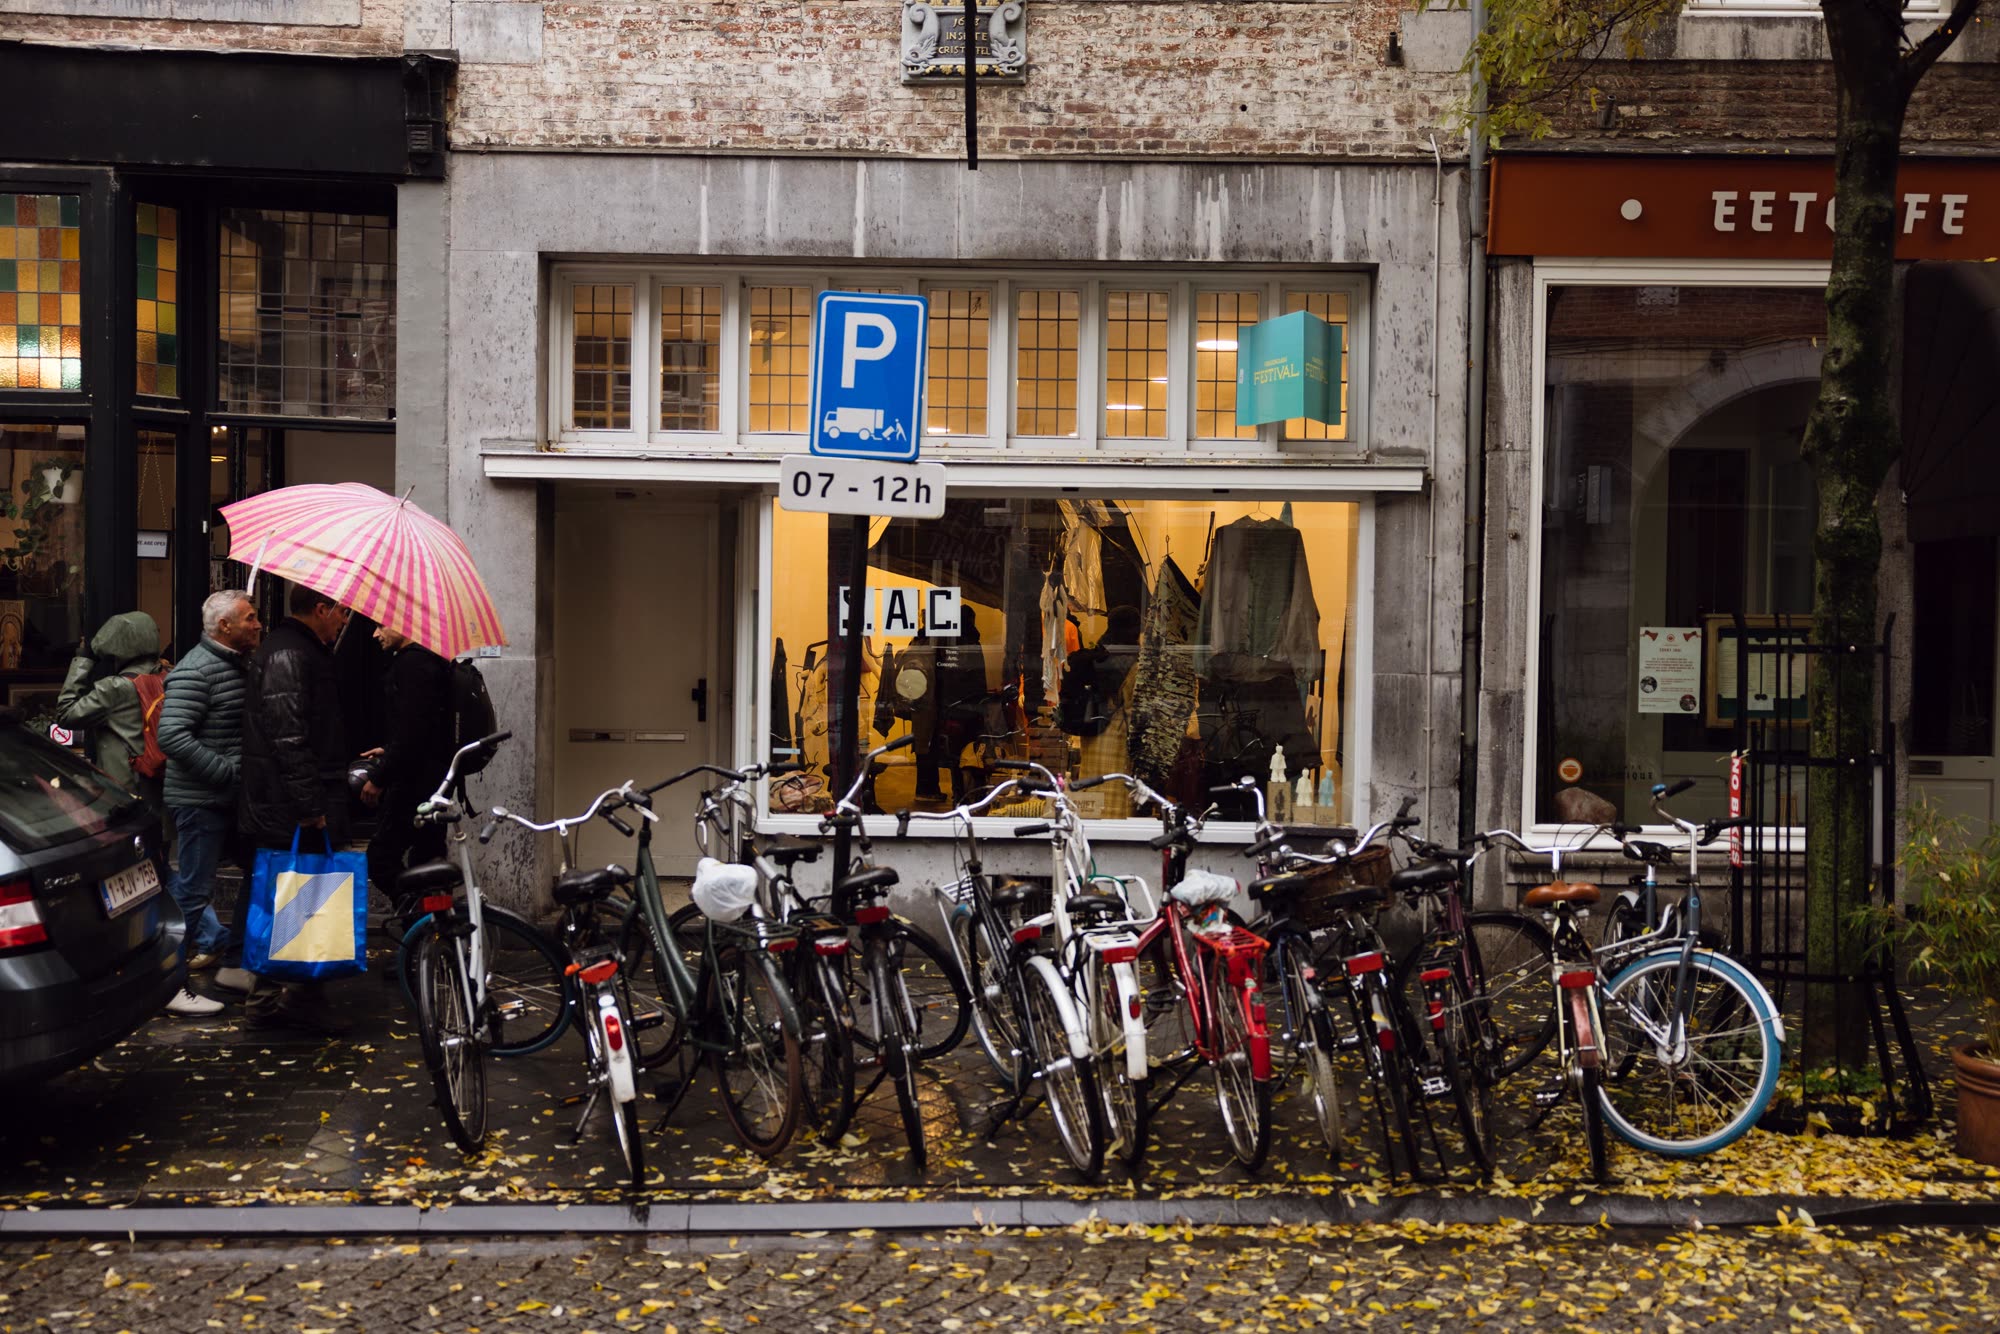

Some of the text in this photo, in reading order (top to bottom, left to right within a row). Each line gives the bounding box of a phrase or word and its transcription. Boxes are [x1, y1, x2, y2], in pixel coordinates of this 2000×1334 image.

[958, 32, 988, 41] SITE
[1711, 190, 1969, 236] EETFE
[840, 311, 898, 390] P
[1253, 363, 1300, 386] FESTIVAL
[792, 470, 835, 499] 07
[872, 476, 932, 504] 12h
[842, 588, 960, 631] .A.C.
[1731, 758, 1740, 791] NO
